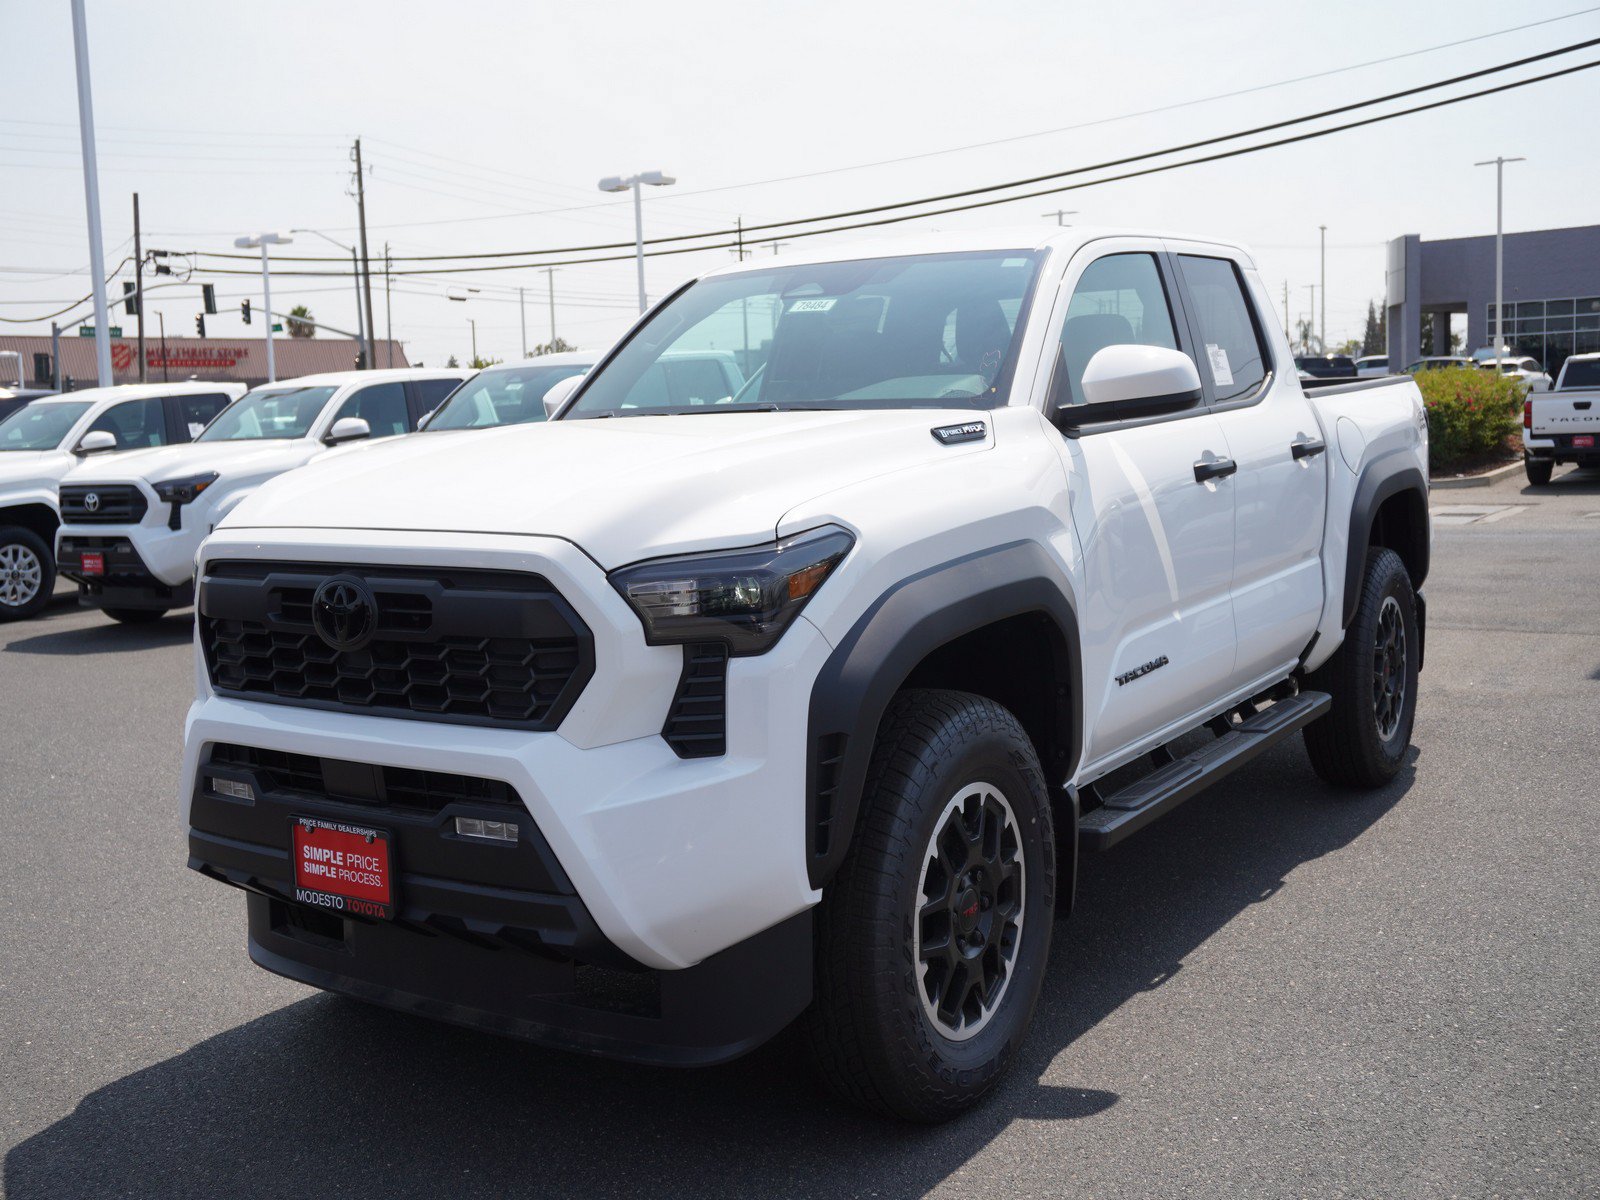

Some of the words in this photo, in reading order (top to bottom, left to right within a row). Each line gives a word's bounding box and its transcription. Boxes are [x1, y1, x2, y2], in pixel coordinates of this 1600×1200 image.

[797, 301, 829, 310] 78484
[217, 347, 249, 358] STORE
[962, 424, 984, 434] MAX
[1114, 654, 1170, 686] TACOMA
[299, 818, 316, 827] PRICE
[318, 820, 337, 830] FAMILY
[338, 824, 377, 838] DEALERSHIPS
[303, 845, 344, 866] SIMPLE
[346, 853, 383, 872] PRICE.
[304, 861, 336, 878] SIMPLE
[338, 868, 384, 887] PROCESS.
[296, 888, 343, 909] MODESTO
[346, 898, 385, 918] TOYOTA
